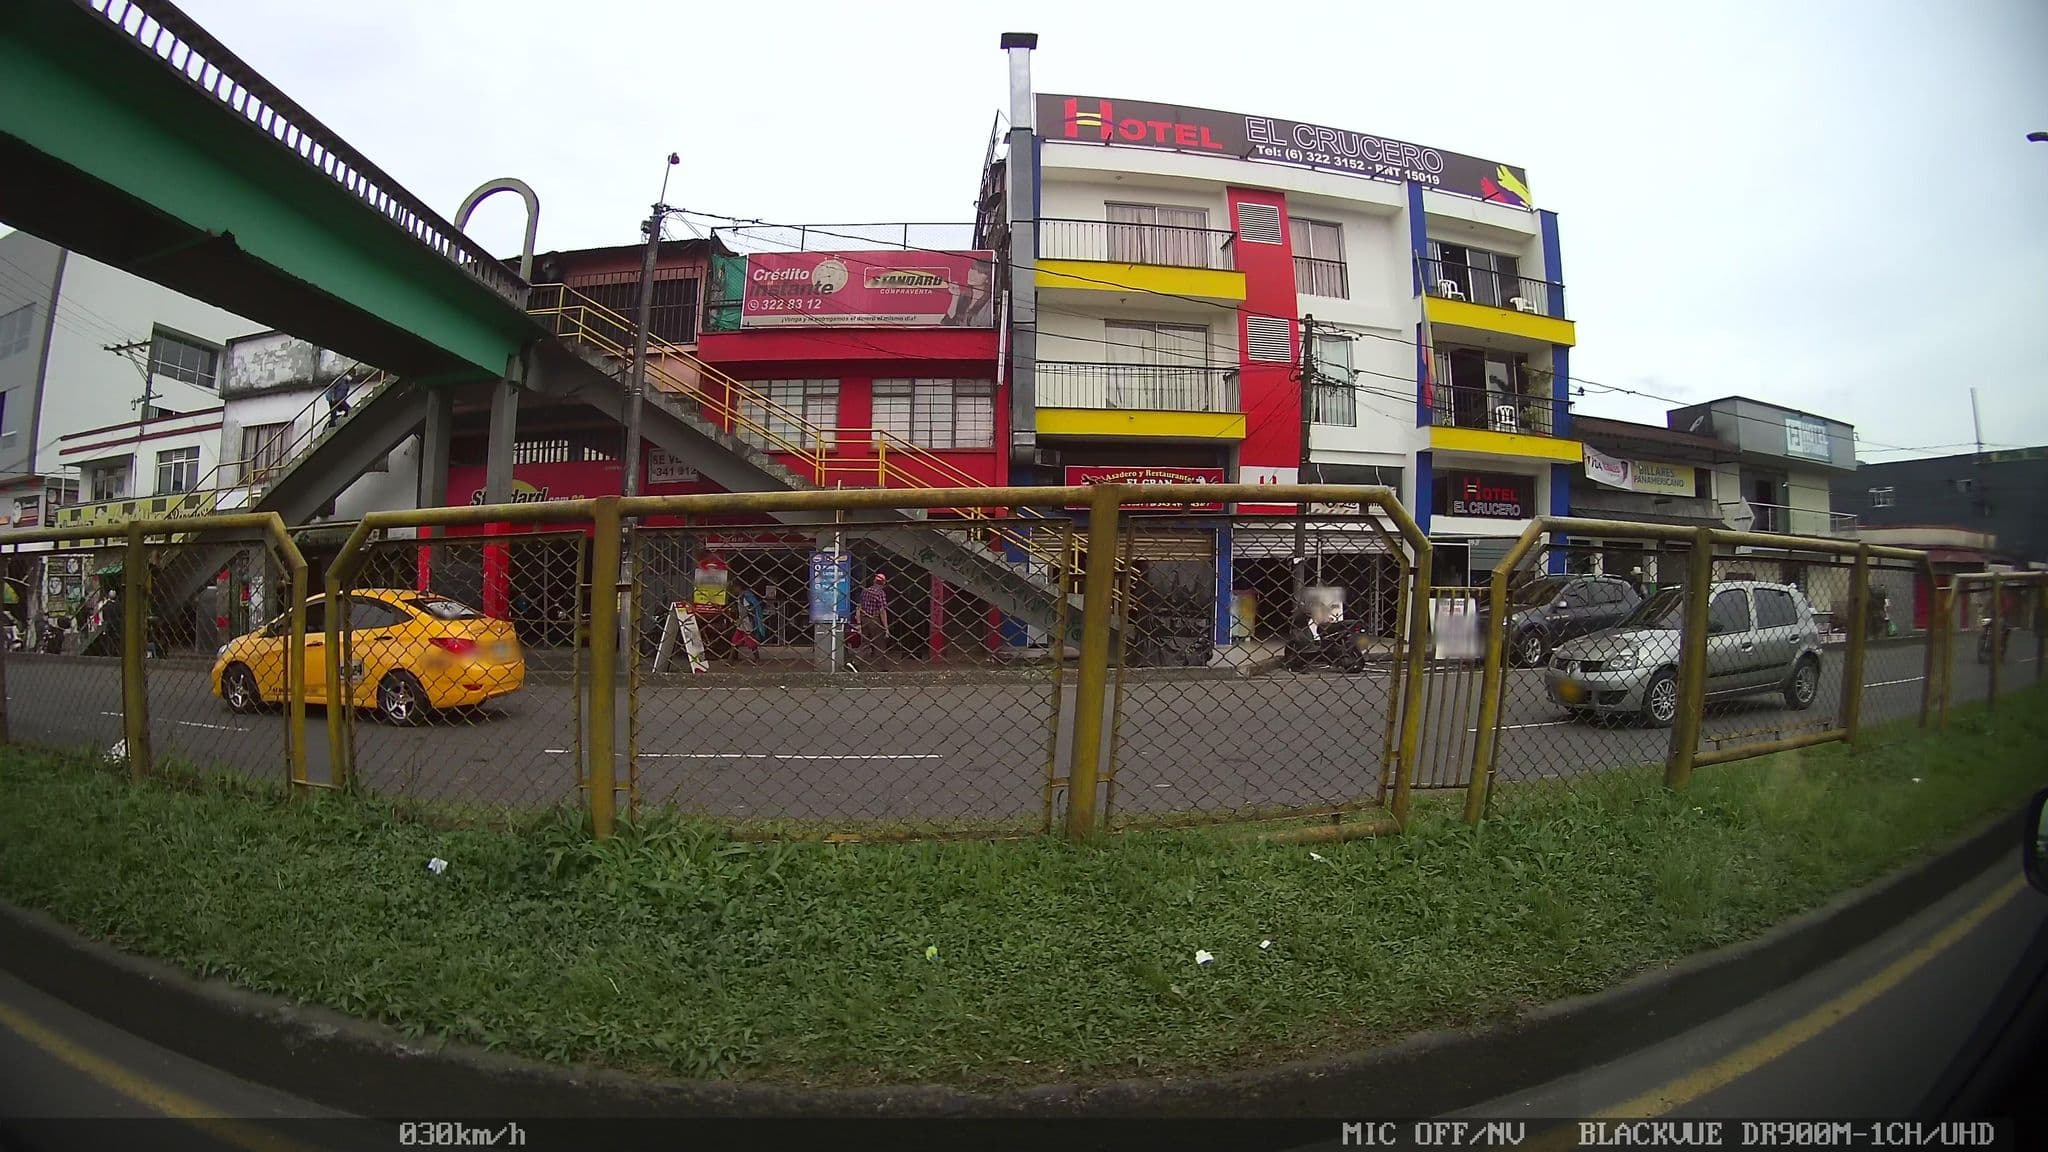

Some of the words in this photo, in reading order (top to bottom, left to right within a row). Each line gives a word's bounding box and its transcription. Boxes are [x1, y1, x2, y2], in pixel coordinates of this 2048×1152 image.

[1063, 97, 1223, 150] HOTEL
[1245, 116, 1288, 146] EL
[1293, 124, 1444, 174] CRUCERO
[1255, 144, 1282, 157] Tel:
[1285, 147, 1303, 162] (6)
[1306, 151, 1331, 165] 322
[1334, 156, 1365, 171] 3152
[1404, 169, 1441, 185] 15019
[753, 266, 810, 281] Crédito
[871, 274, 944, 287] STANDARD
[879, 288, 933, 296] COMPRAVENTA
[761, 300, 784, 310] 322
[787, 299, 802, 310] 83
[807, 299, 822, 309] 12
[652, 455, 665, 465] SE
[1105, 471, 1137, 482] Asadero
[1463, 477, 1519, 502] HOTEL
[1453, 500, 1468, 514] EL
[1469, 501, 1521, 516] CRUCERO
